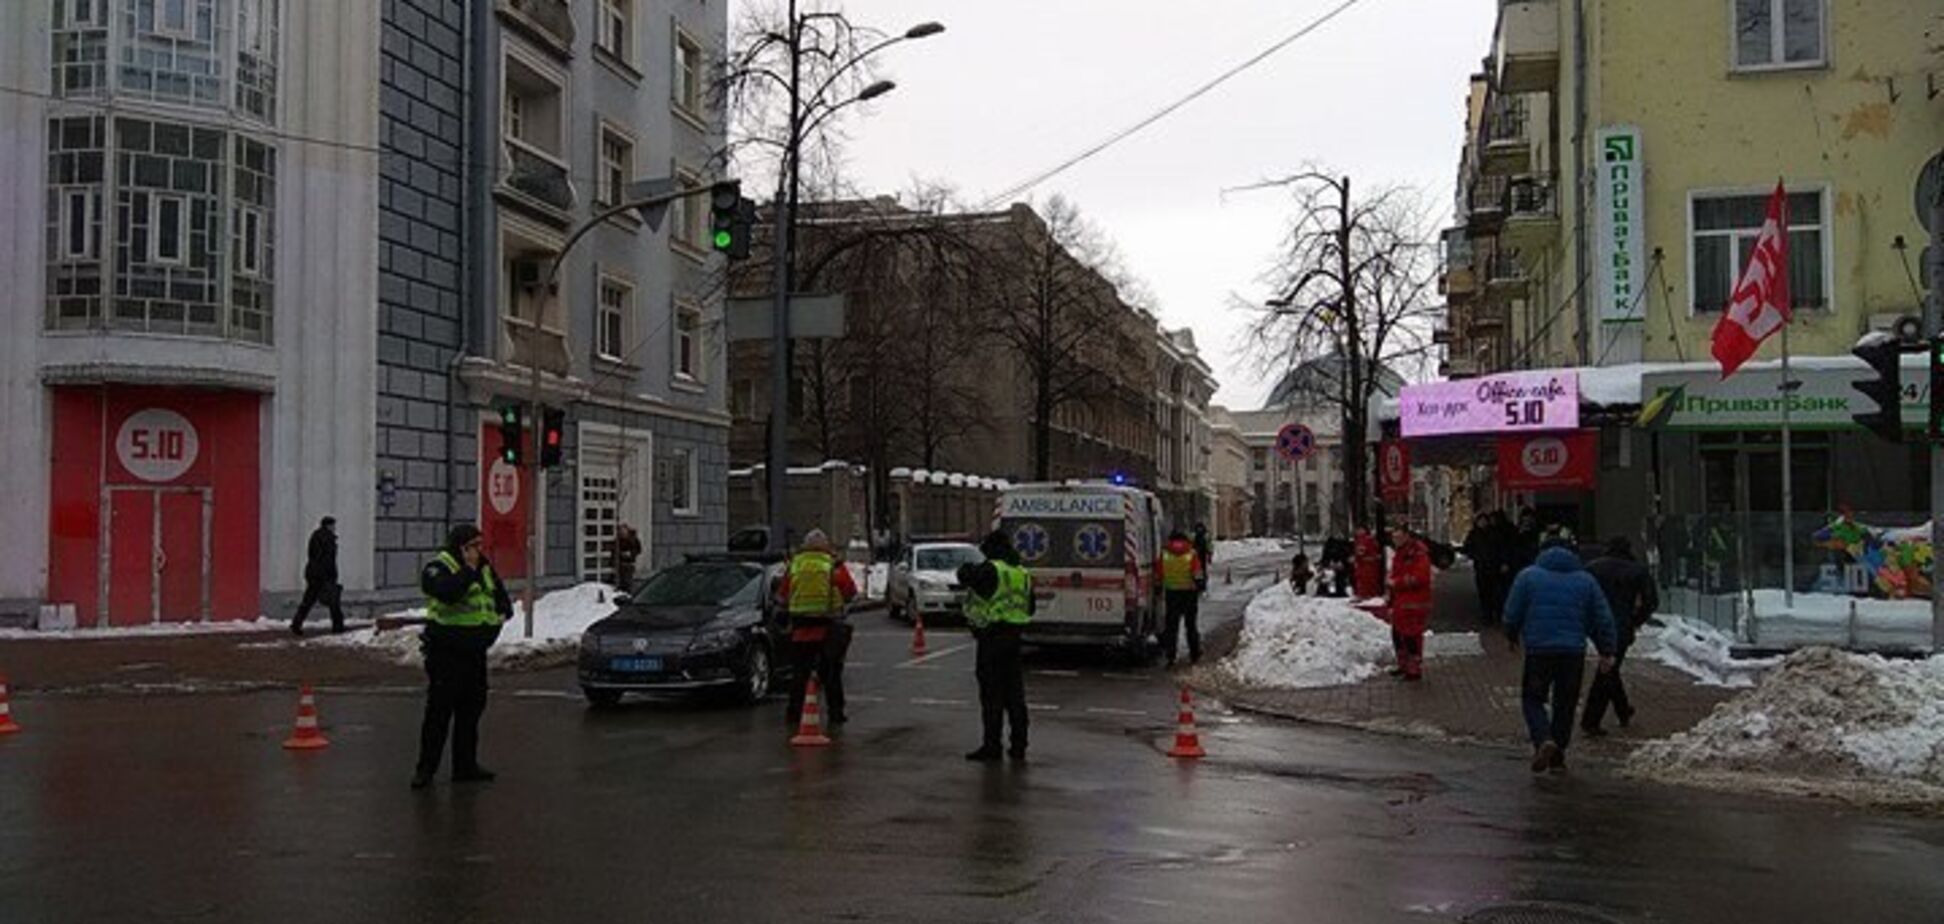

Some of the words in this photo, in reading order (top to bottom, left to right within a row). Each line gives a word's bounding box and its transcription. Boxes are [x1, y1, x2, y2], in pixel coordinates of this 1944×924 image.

[1611, 164, 1630, 309] ПриватБанк
[1506, 400, 1545, 425] 5.10
[1687, 394, 1849, 415] ПриватБанк
[131, 429, 184, 460] 5.10
[1009, 498, 1118, 513] AMBULANCE
[1086, 597, 1113, 612] 103
